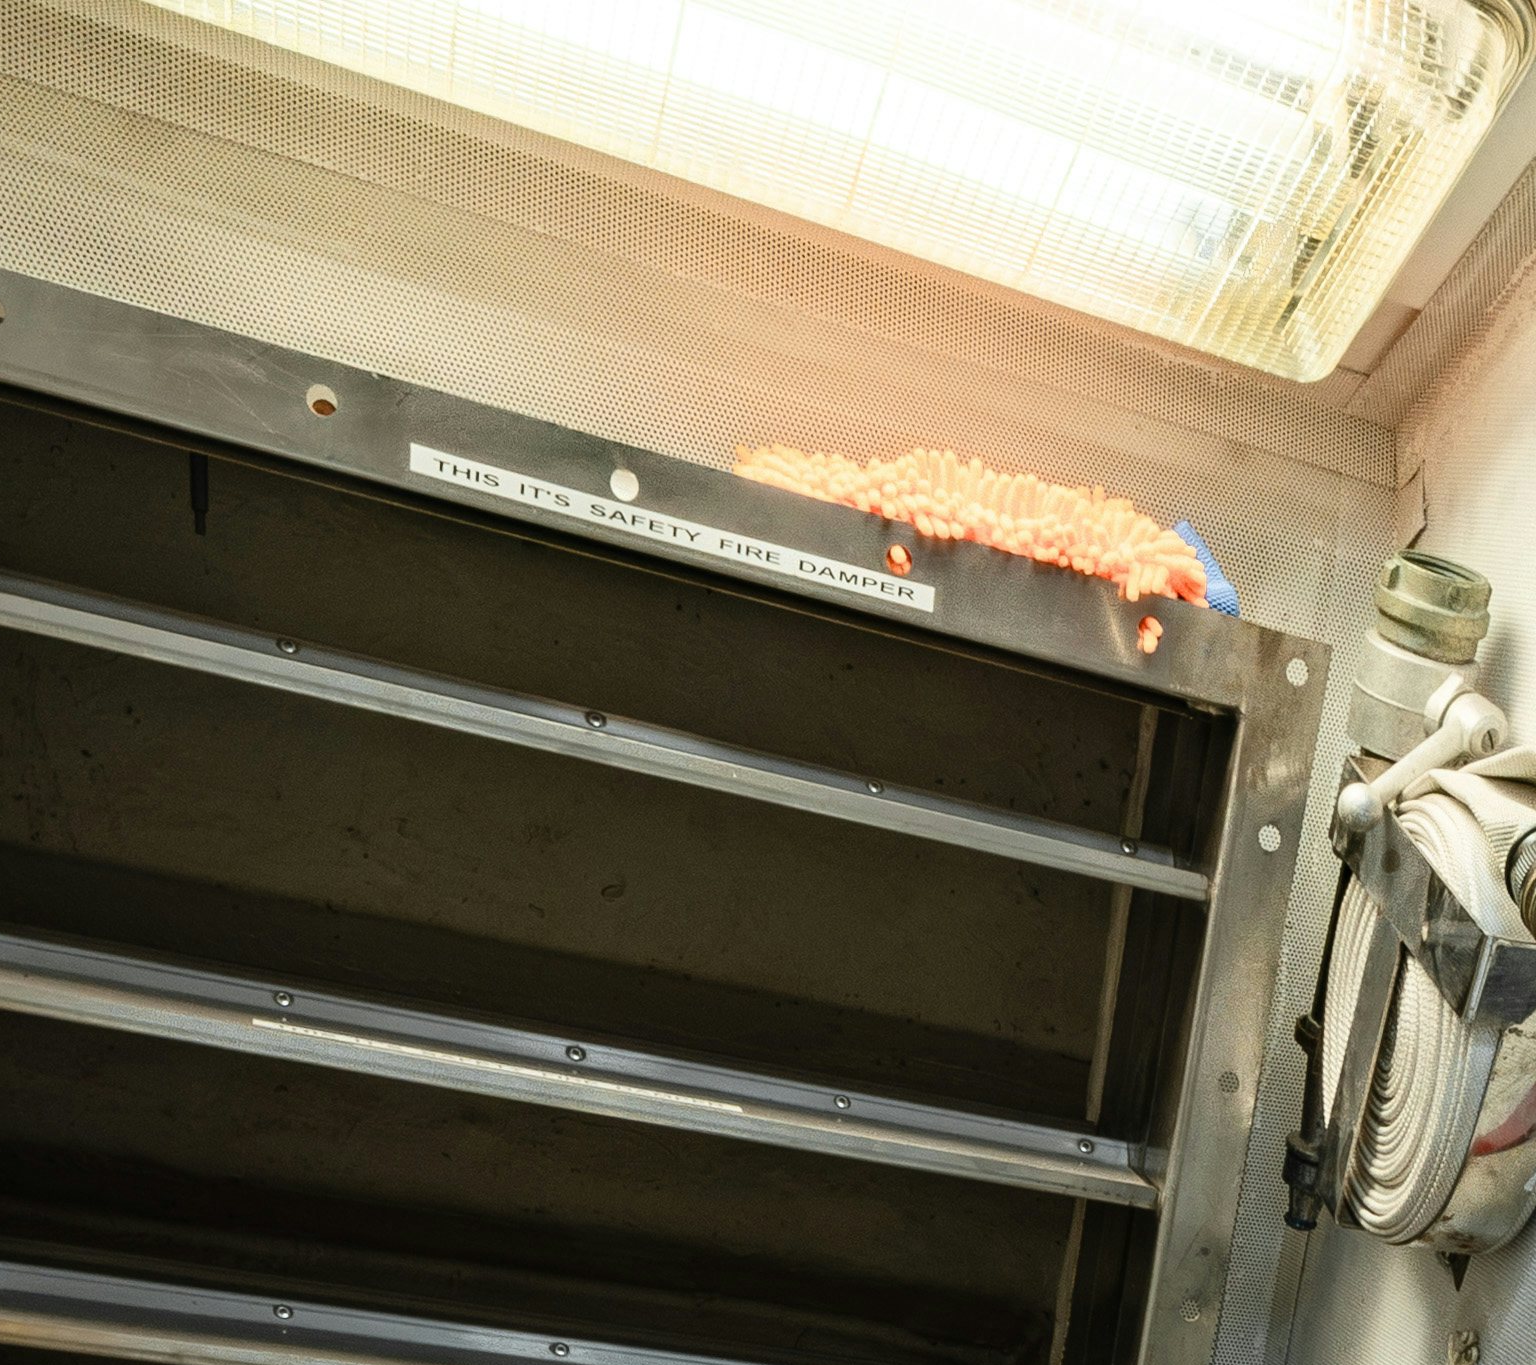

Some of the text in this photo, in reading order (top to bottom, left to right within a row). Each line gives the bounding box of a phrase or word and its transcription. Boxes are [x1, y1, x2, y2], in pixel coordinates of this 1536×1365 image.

[432, 456, 916, 601] THIS IT'S SAFETY FIRE DAMPER
